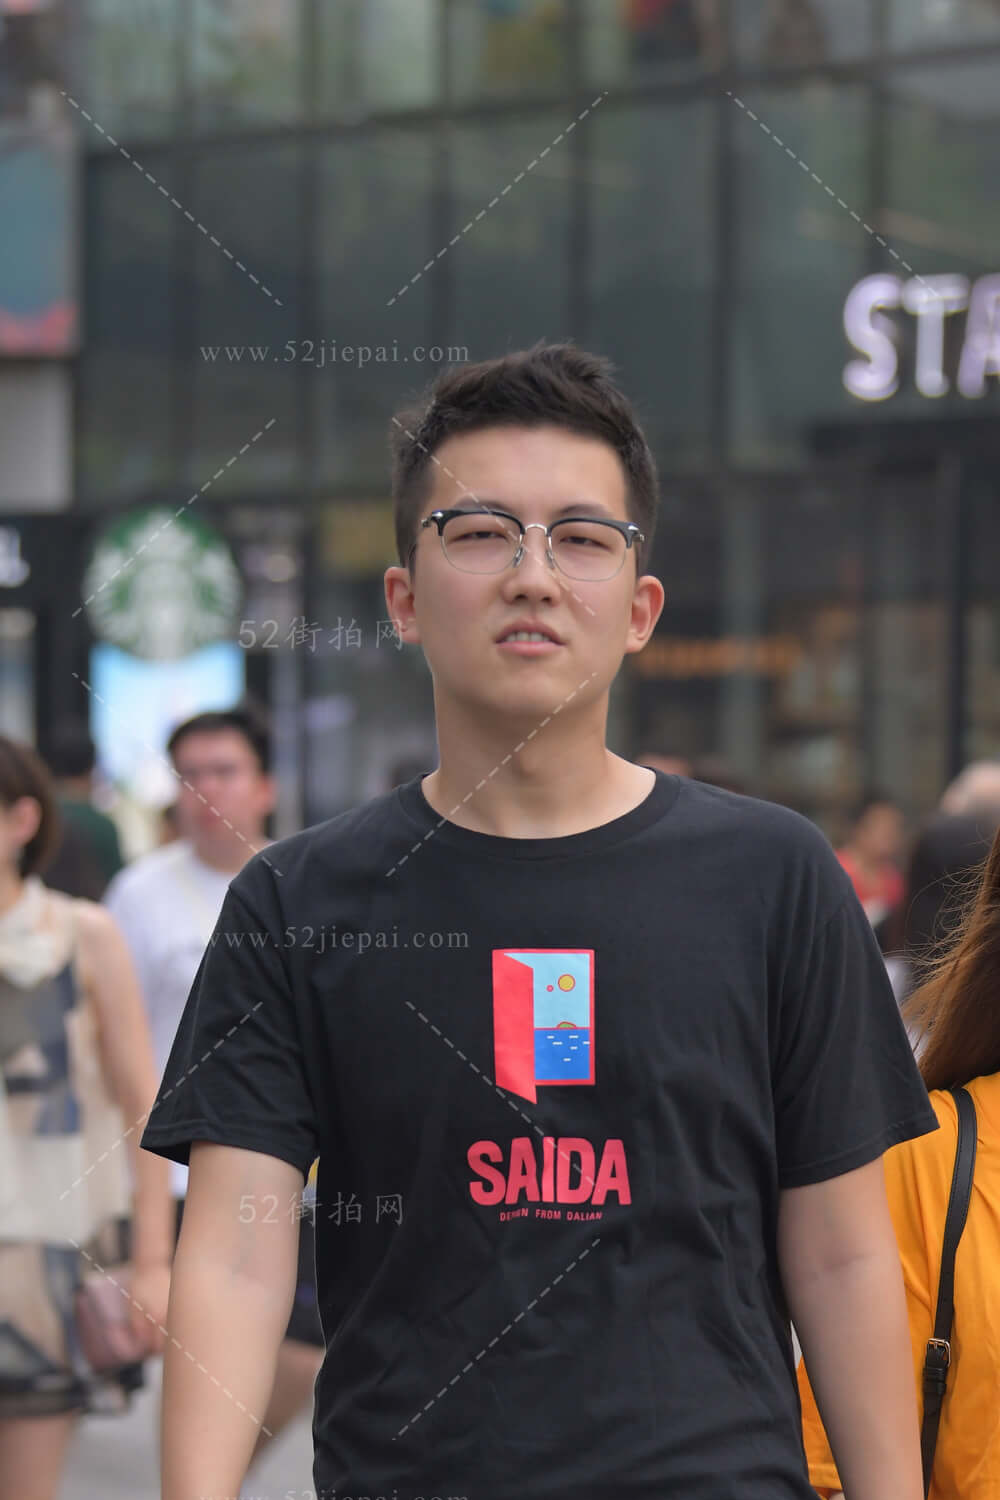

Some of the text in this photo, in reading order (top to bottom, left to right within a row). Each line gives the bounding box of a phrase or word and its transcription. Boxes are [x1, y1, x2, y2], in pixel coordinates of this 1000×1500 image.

[467, 1136, 632, 1206] SAIDA
[535, 1208, 562, 1220] FROM
[566, 1210, 603, 1221] DALIAN
